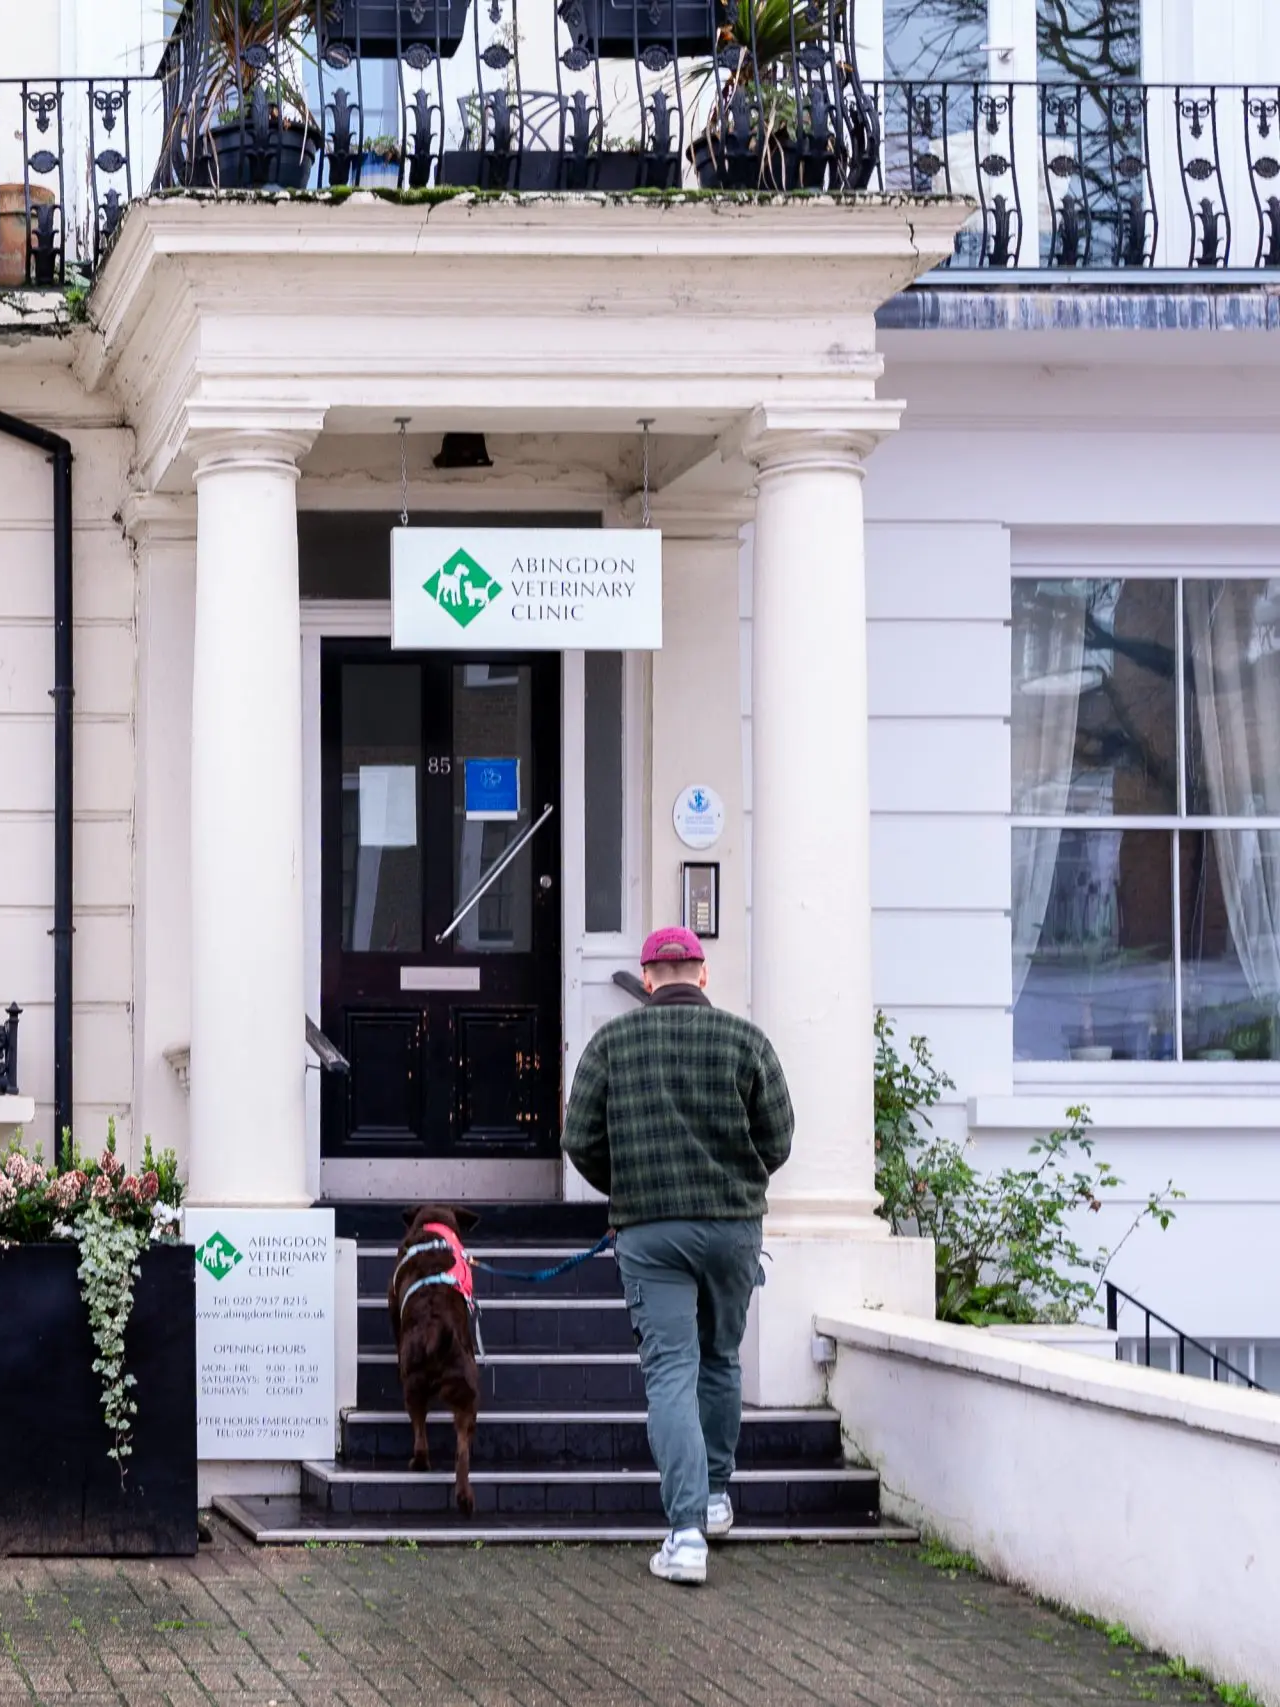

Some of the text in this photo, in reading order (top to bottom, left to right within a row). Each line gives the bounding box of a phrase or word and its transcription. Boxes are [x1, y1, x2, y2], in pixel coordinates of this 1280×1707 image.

[511, 557, 635, 574] ABINGDON
[511, 581, 636, 598] VETERINARY
[511, 604, 585, 622] CLINIC
[428, 757, 450, 775] 85
[249, 1236, 327, 1247] ABINGDON
[249, 1251, 327, 1262] VETERINARY
[249, 1267, 294, 1277] CLINIC
[233, 1296, 252, 1305] 020
[283, 1296, 308, 1306] 8215
[214, 1344, 306, 1355] OPENING HOURS
[202, 1364, 226, 1372] MON
[266, 1364, 285, 1372] 9.00
[202, 1375, 260, 1384] SATURDAYS:
[266, 1376, 285, 1384] 9.00
[266, 1387, 303, 1395] CLOSED
[198, 1417, 328, 1425] FTER HOURS EMERGENCIES
[236, 1429, 253, 1438] 020
